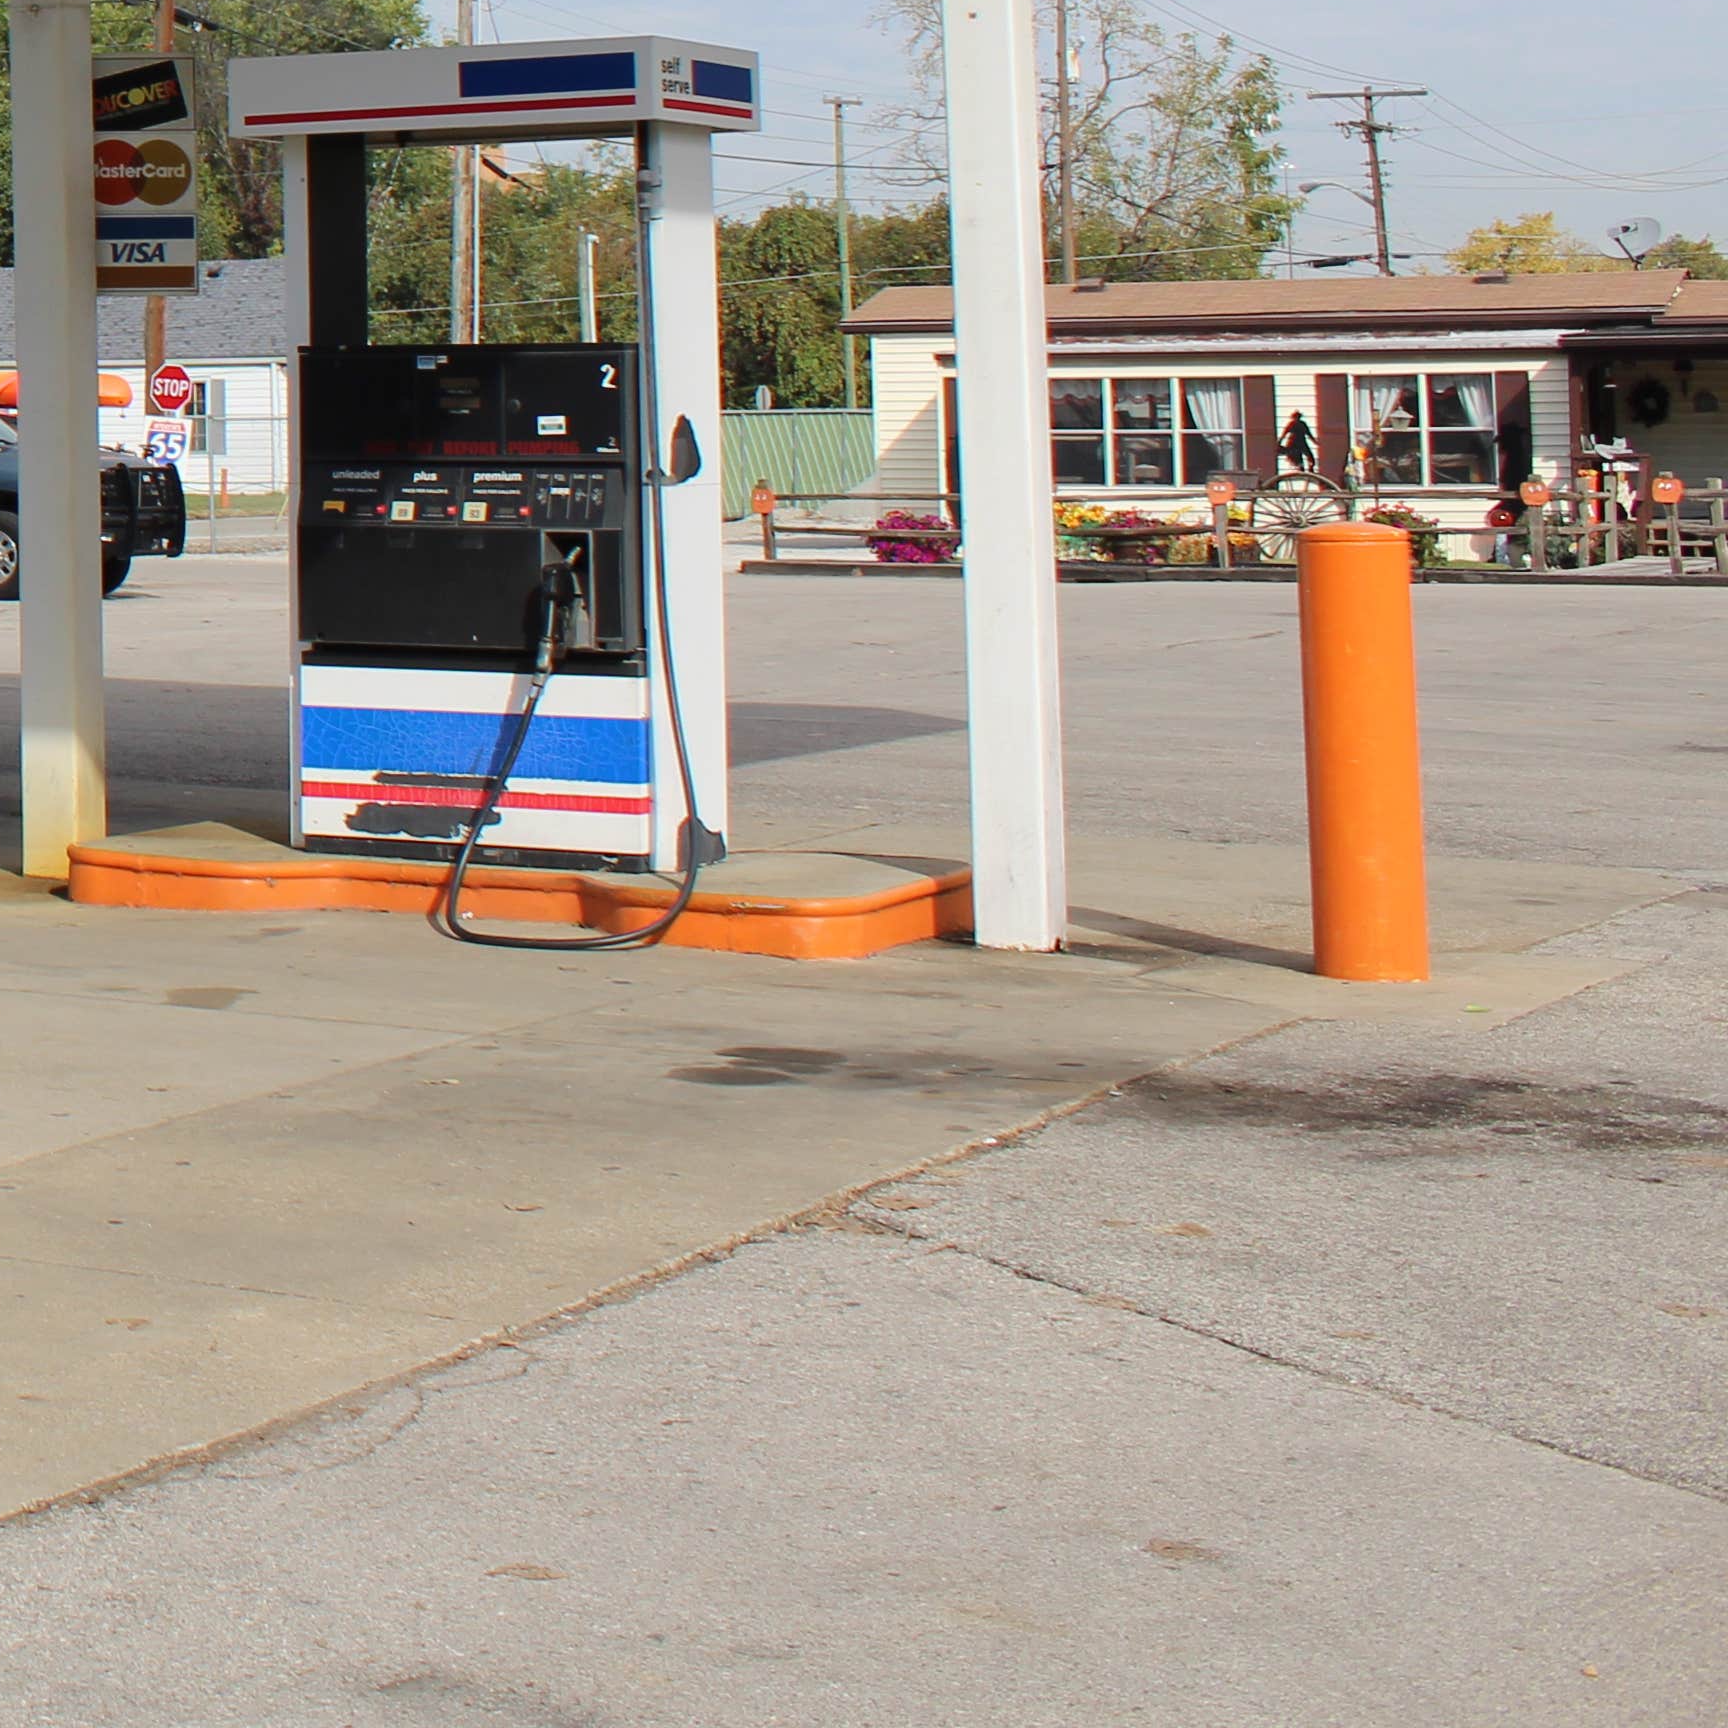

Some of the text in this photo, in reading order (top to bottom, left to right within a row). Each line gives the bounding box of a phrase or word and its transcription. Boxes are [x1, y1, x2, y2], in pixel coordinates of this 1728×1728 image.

[661, 56, 680, 74] self
[661, 78, 691, 95] serve
[95, 163, 186, 179] asterCard
[110, 242, 166, 263] VISA
[600, 363, 618, 389] 2
[154, 378, 189, 397] STOP
[150, 433, 182, 459] 65
[332, 469, 380, 480] unleaded
[413, 470, 438, 483] plus
[473, 470, 523, 483] premium
